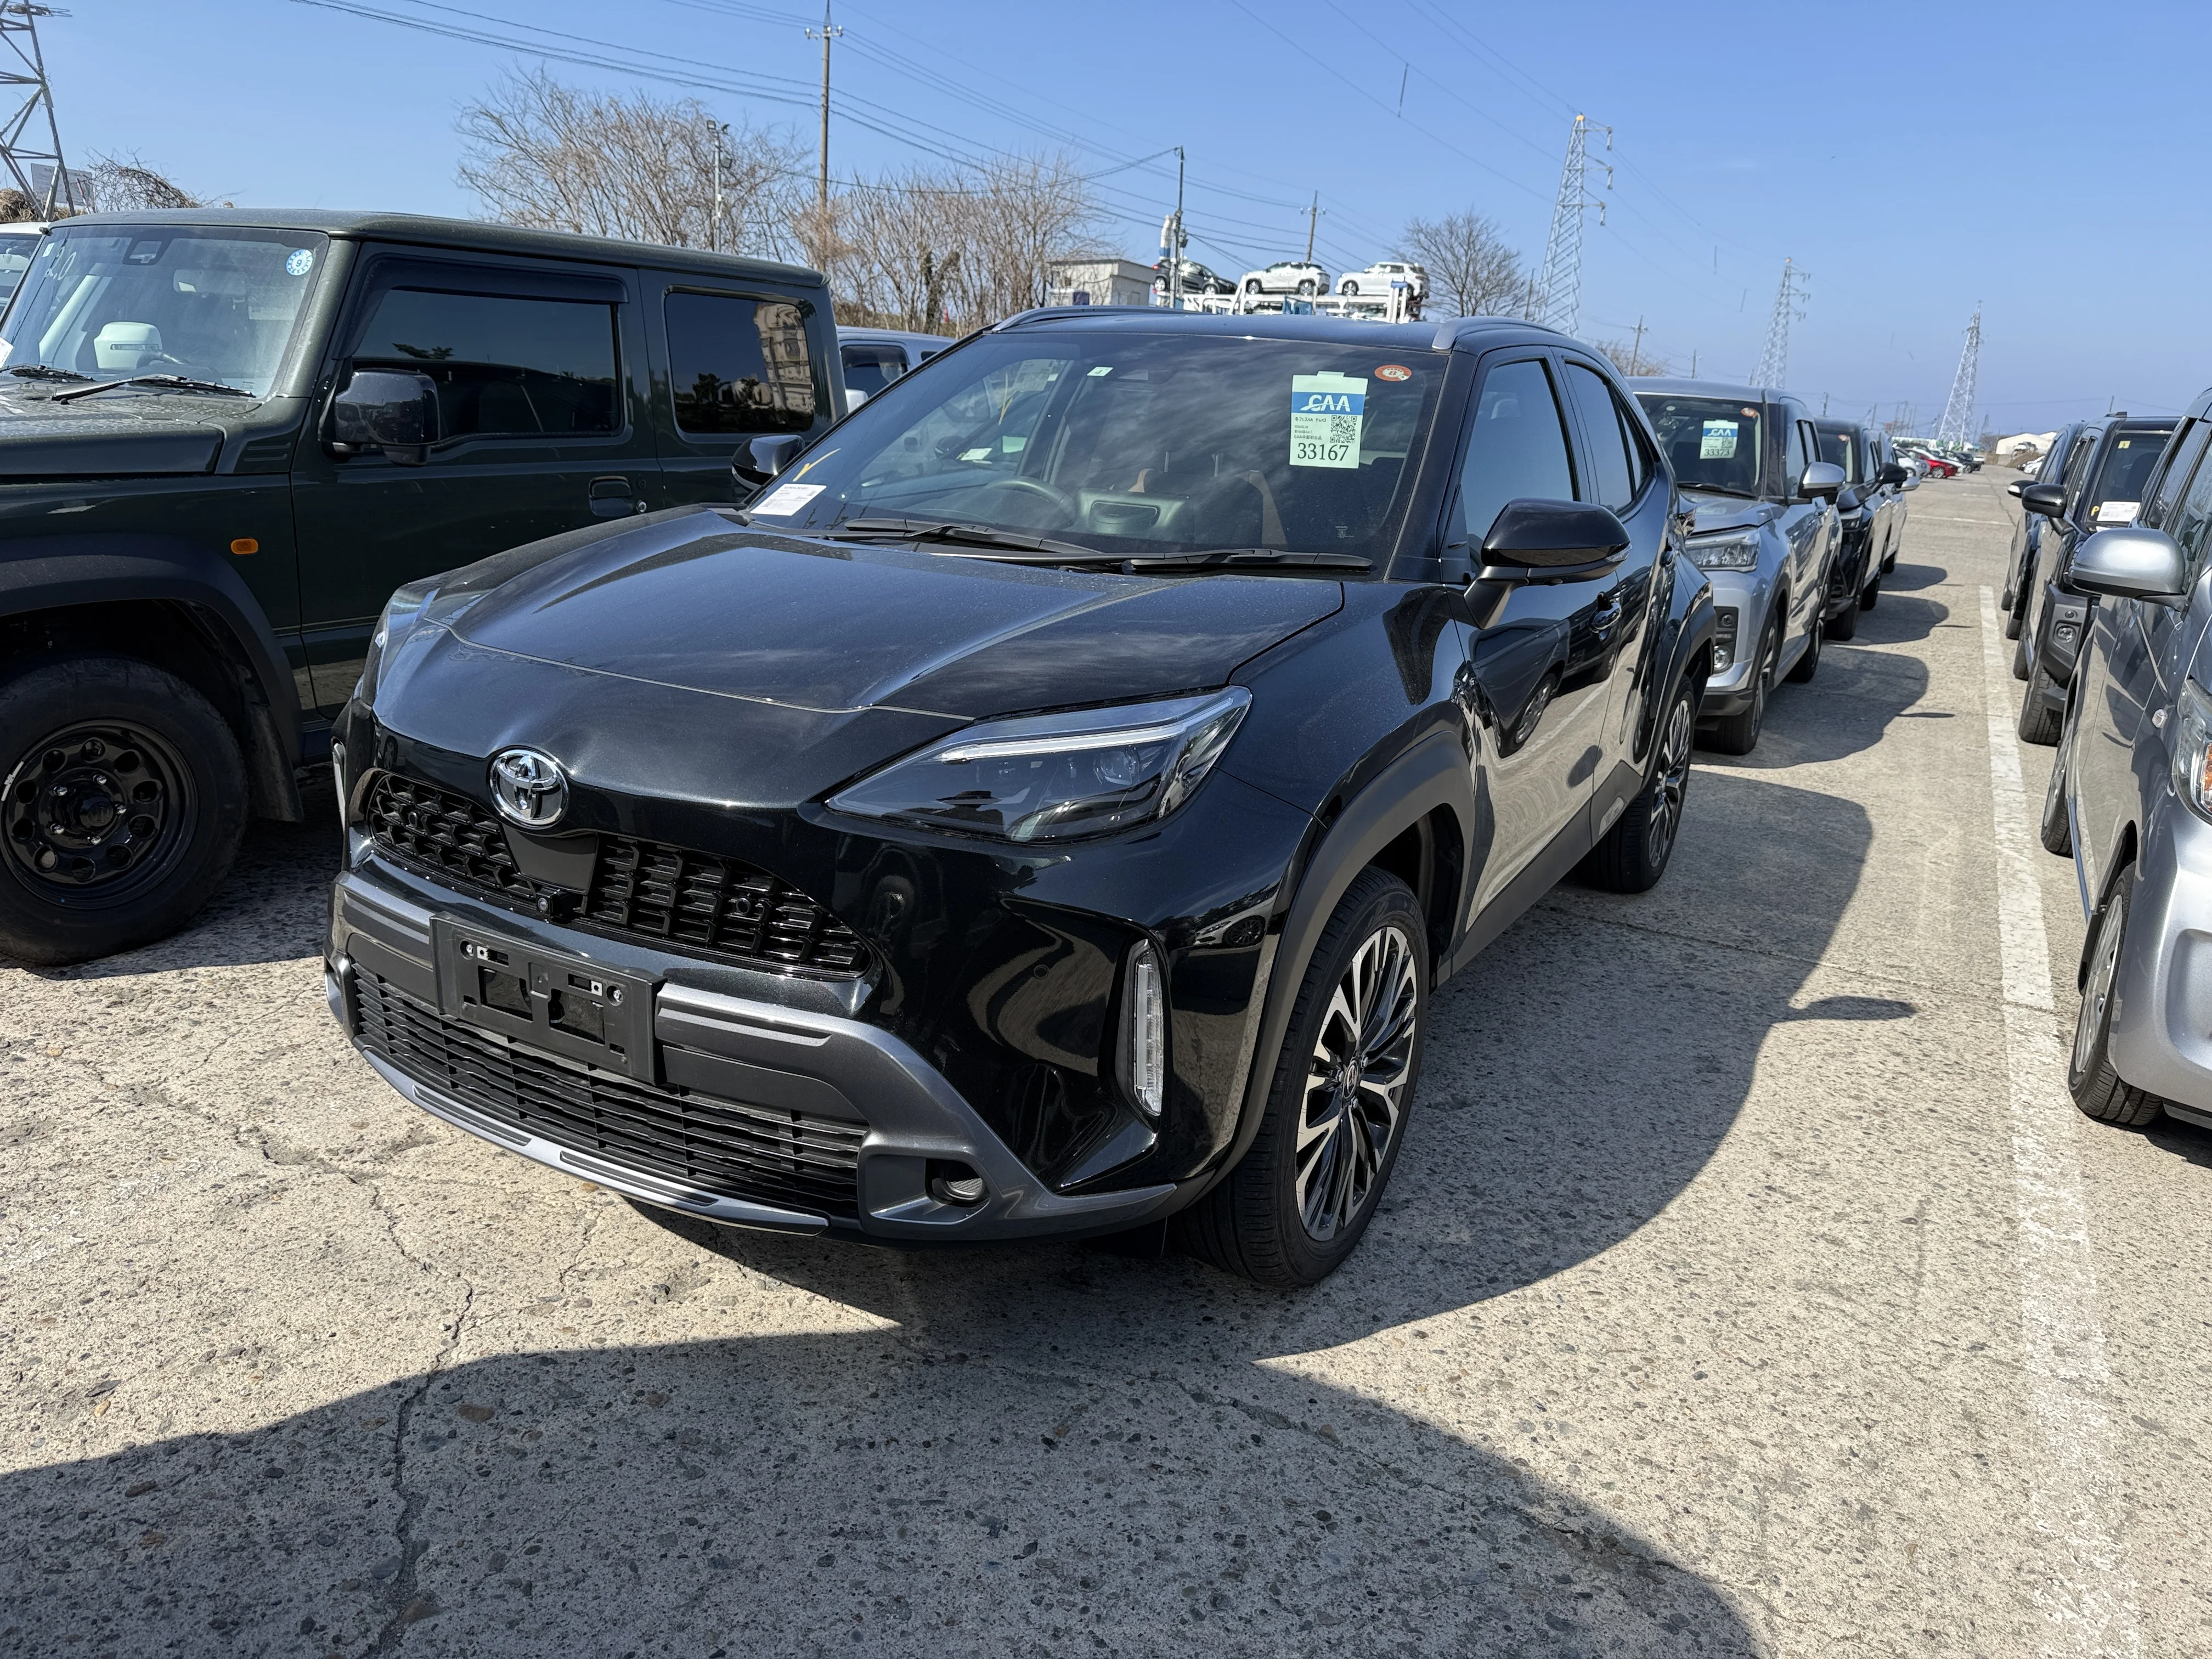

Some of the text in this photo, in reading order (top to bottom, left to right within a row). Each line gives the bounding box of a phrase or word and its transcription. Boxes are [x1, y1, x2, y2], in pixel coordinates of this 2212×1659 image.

[296, 259, 302, 267] 9
[1299, 394, 1351, 413] CAA
[1707, 428, 1732, 437] CAA
[1297, 442, 1349, 461] 33167
[1704, 448, 1730, 456] 33373
